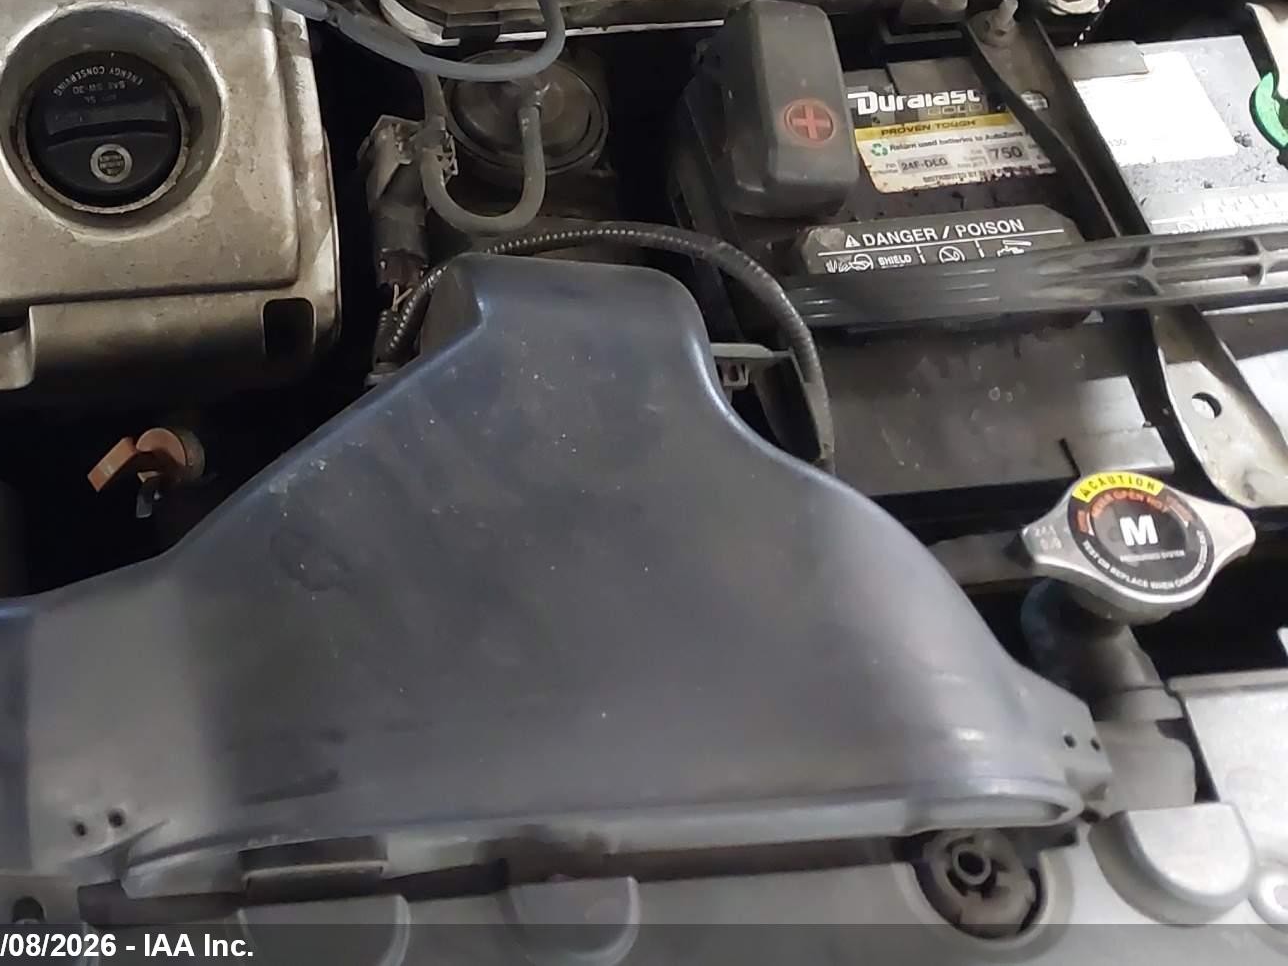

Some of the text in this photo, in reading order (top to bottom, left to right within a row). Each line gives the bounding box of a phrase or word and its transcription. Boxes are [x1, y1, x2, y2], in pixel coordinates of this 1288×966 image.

[847, 89, 981, 115] Duralast
[880, 120, 977, 136] PROVEN TOUGH
[889, 142, 917, 152] Return
[918, 139, 938, 148] used
[938, 136, 973, 145] batteries
[988, 145, 1024, 160] 750
[862, 227, 938, 246] DANGER
[955, 219, 1025, 236] POISON
[878, 254, 913, 266] SHIELD
[1088, 475, 1156, 492] CAUTION
[1119, 514, 1159, 546] M
[1109, 566, 1149, 589] REPLACE
